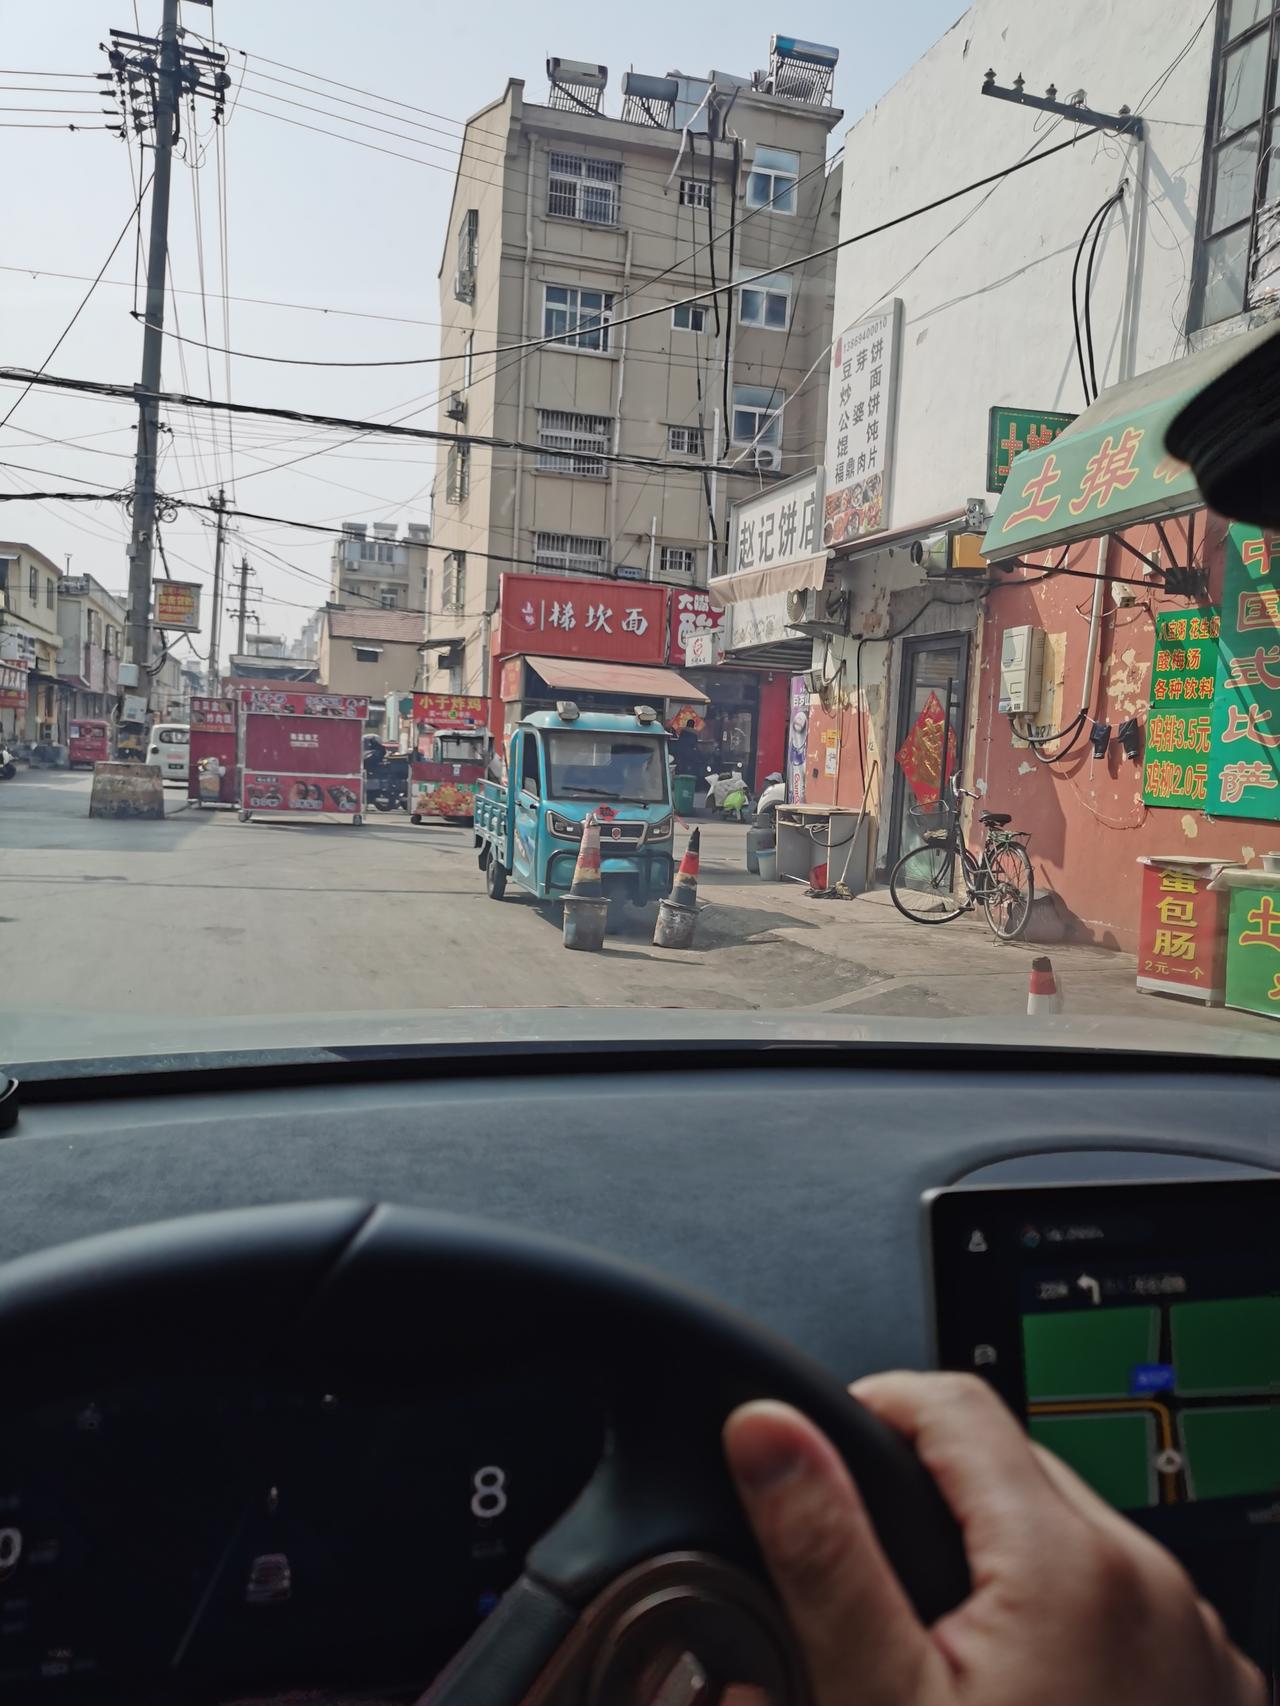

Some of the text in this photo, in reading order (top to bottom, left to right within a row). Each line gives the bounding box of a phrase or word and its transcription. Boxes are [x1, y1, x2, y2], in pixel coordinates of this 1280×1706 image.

[840, 336, 884, 382] 豆芽饼
[838, 391, 882, 433] 公婆饼
[836, 422, 881, 461] 馄饨
[834, 449, 878, 485] 福鼎肉片
[738, 491, 817, 571] 赵记饼店
[548, 600, 649, 636] 梯坎面
[1156, 647, 1201, 671] 酸梅汤
[1154, 676, 1214, 700] 各种饮料
[1148, 714, 1211, 753] 鸡排3.5元
[1145, 759, 1209, 800] 鸡柳2.0元
[1152, 868, 1199, 961] 蛋包肠
[1144, 960, 1205, 980] 2元一个
[471, 1465, 507, 1518] 8
